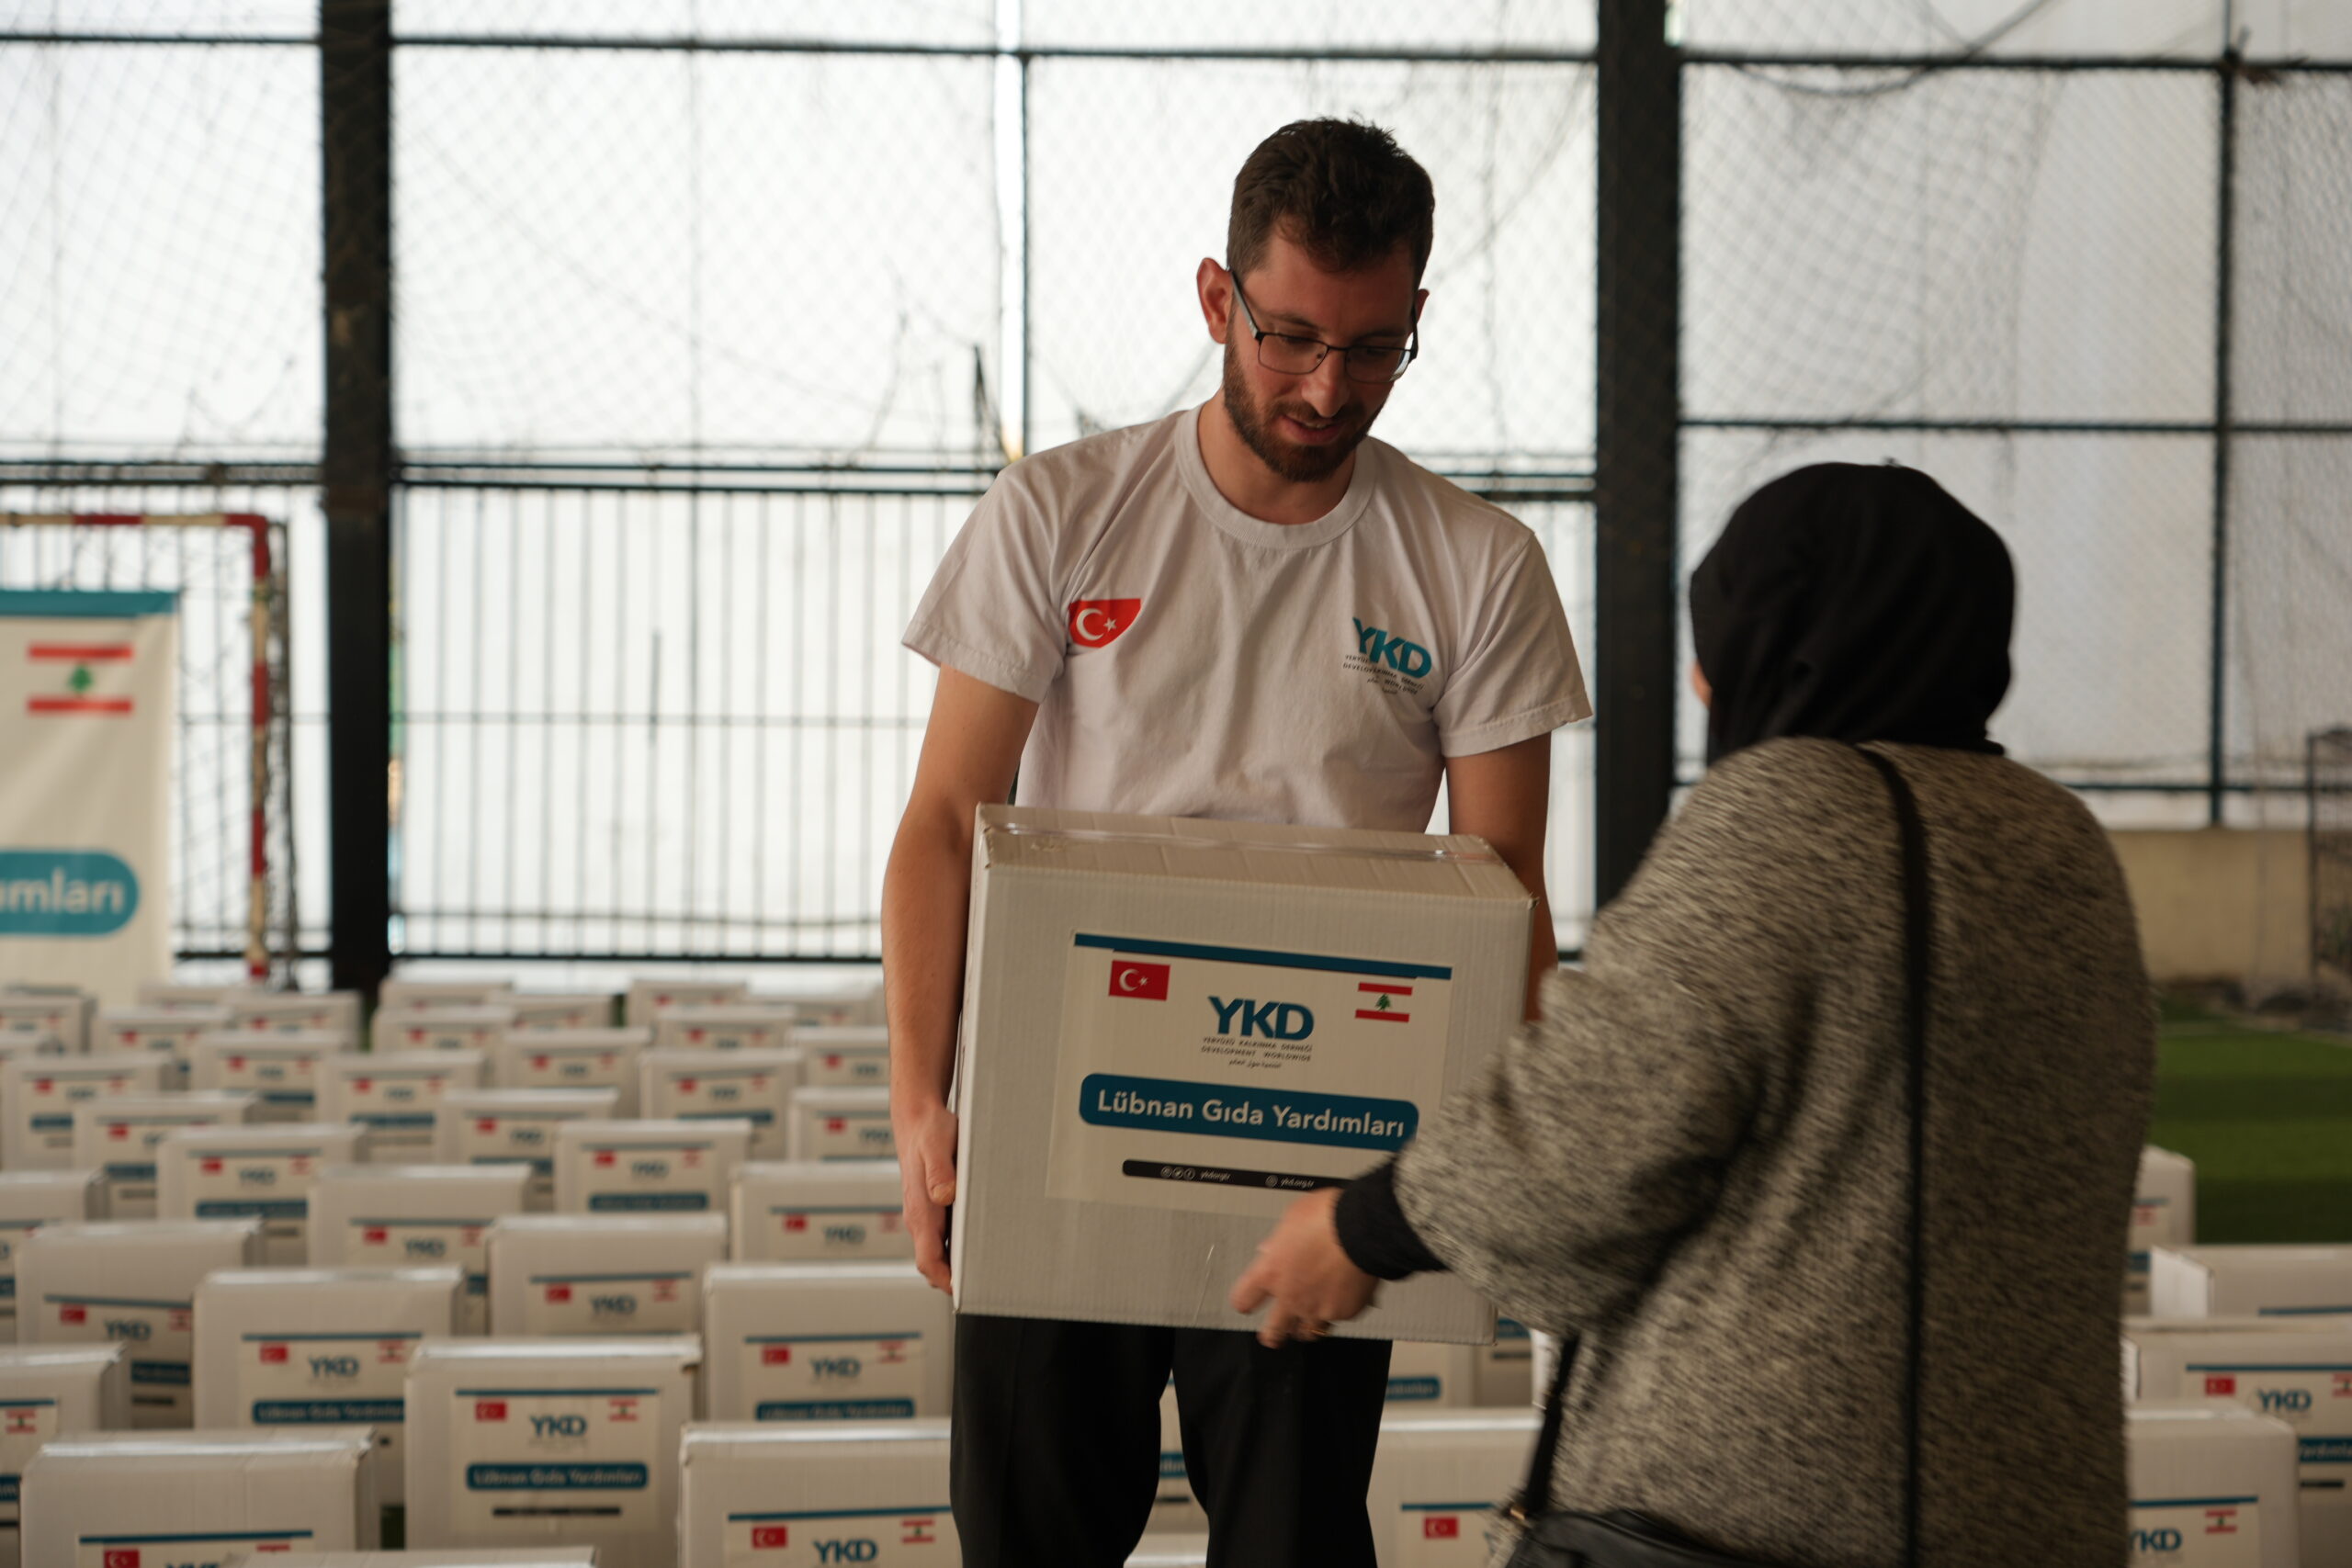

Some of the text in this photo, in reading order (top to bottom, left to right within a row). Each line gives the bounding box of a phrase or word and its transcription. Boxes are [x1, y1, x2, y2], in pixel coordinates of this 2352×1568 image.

[1352, 617, 1432, 679] YKD
[1207, 996, 1315, 1041] YKD
[1098, 1089, 1405, 1138] Lübnan Gıda Yardımları
[2257, 1388, 2312, 1412] YKD
[530, 1416, 588, 1437] YKD
[813, 1540, 878, 1563] YKD
